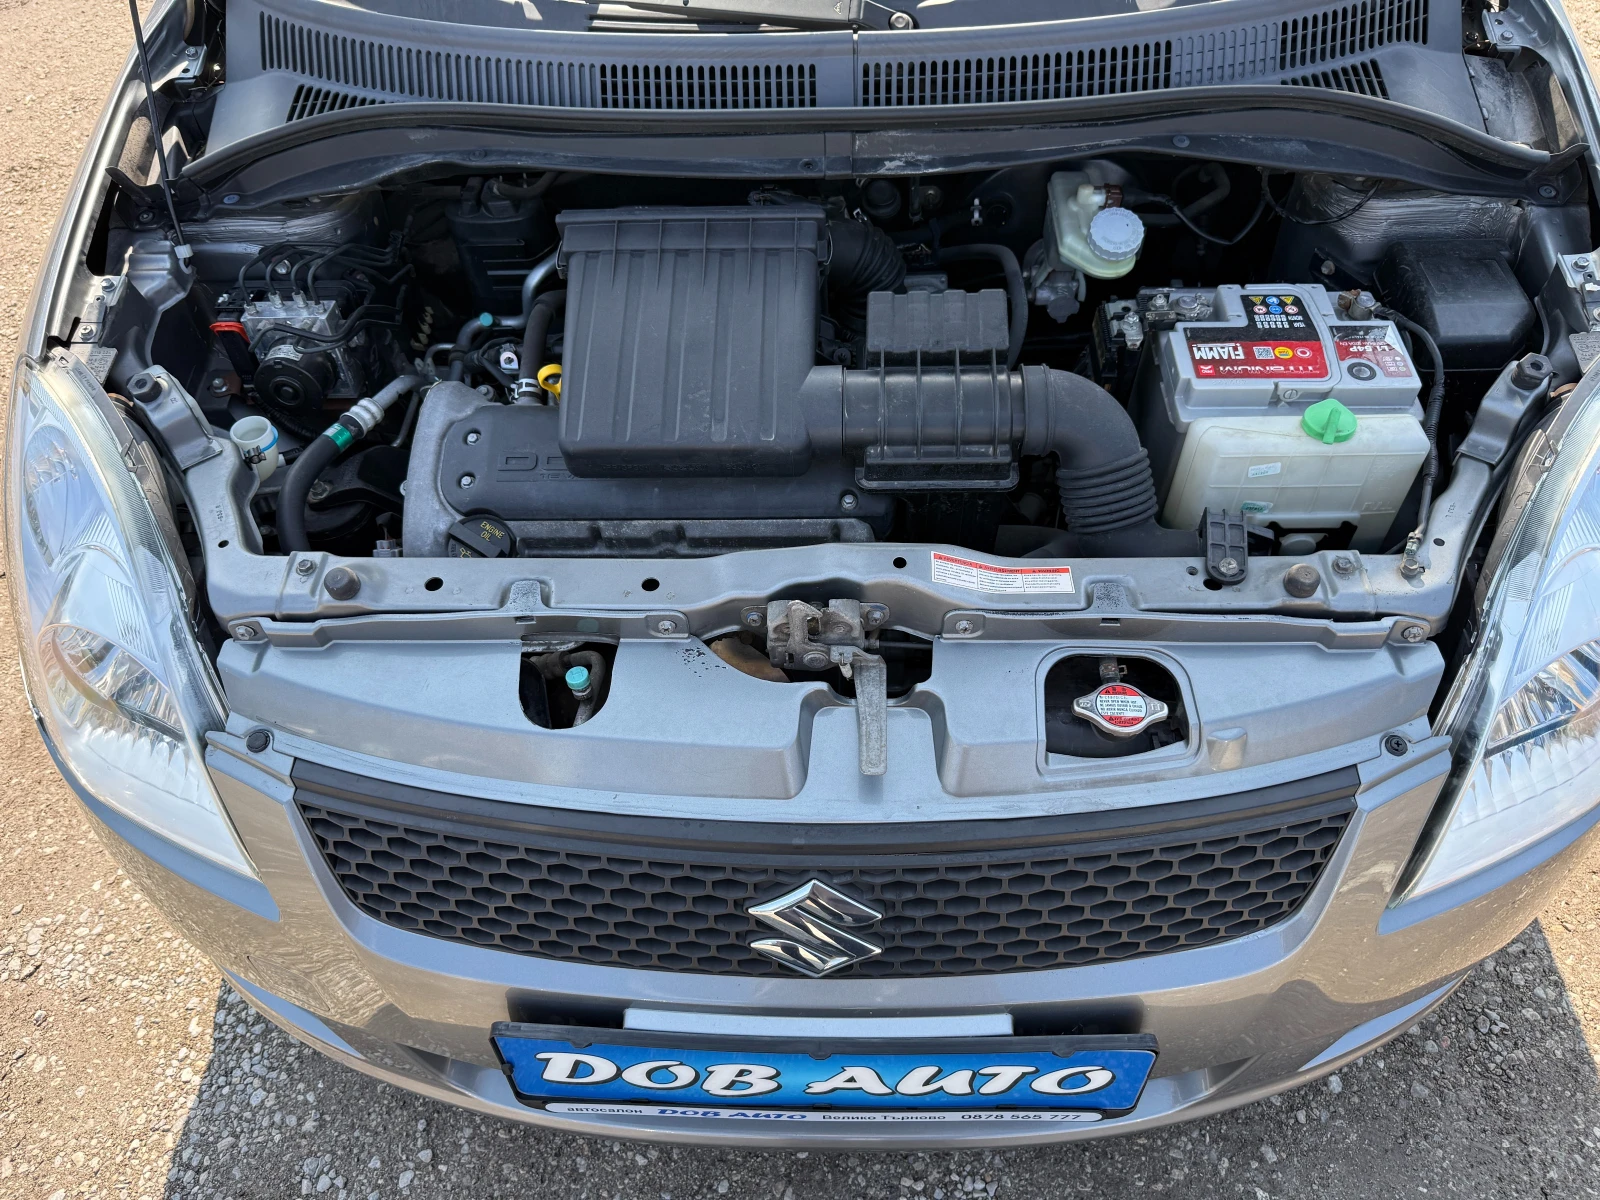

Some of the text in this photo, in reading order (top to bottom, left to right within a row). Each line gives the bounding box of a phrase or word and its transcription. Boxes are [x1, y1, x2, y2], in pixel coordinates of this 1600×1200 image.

[1192, 346, 1245, 360] FIAMM
[480, 521, 505, 539] ENGINE
[480, 531, 491, 542] OIL
[534, 1052, 782, 1096] DOB
[657, 1108, 721, 1117] DOB
